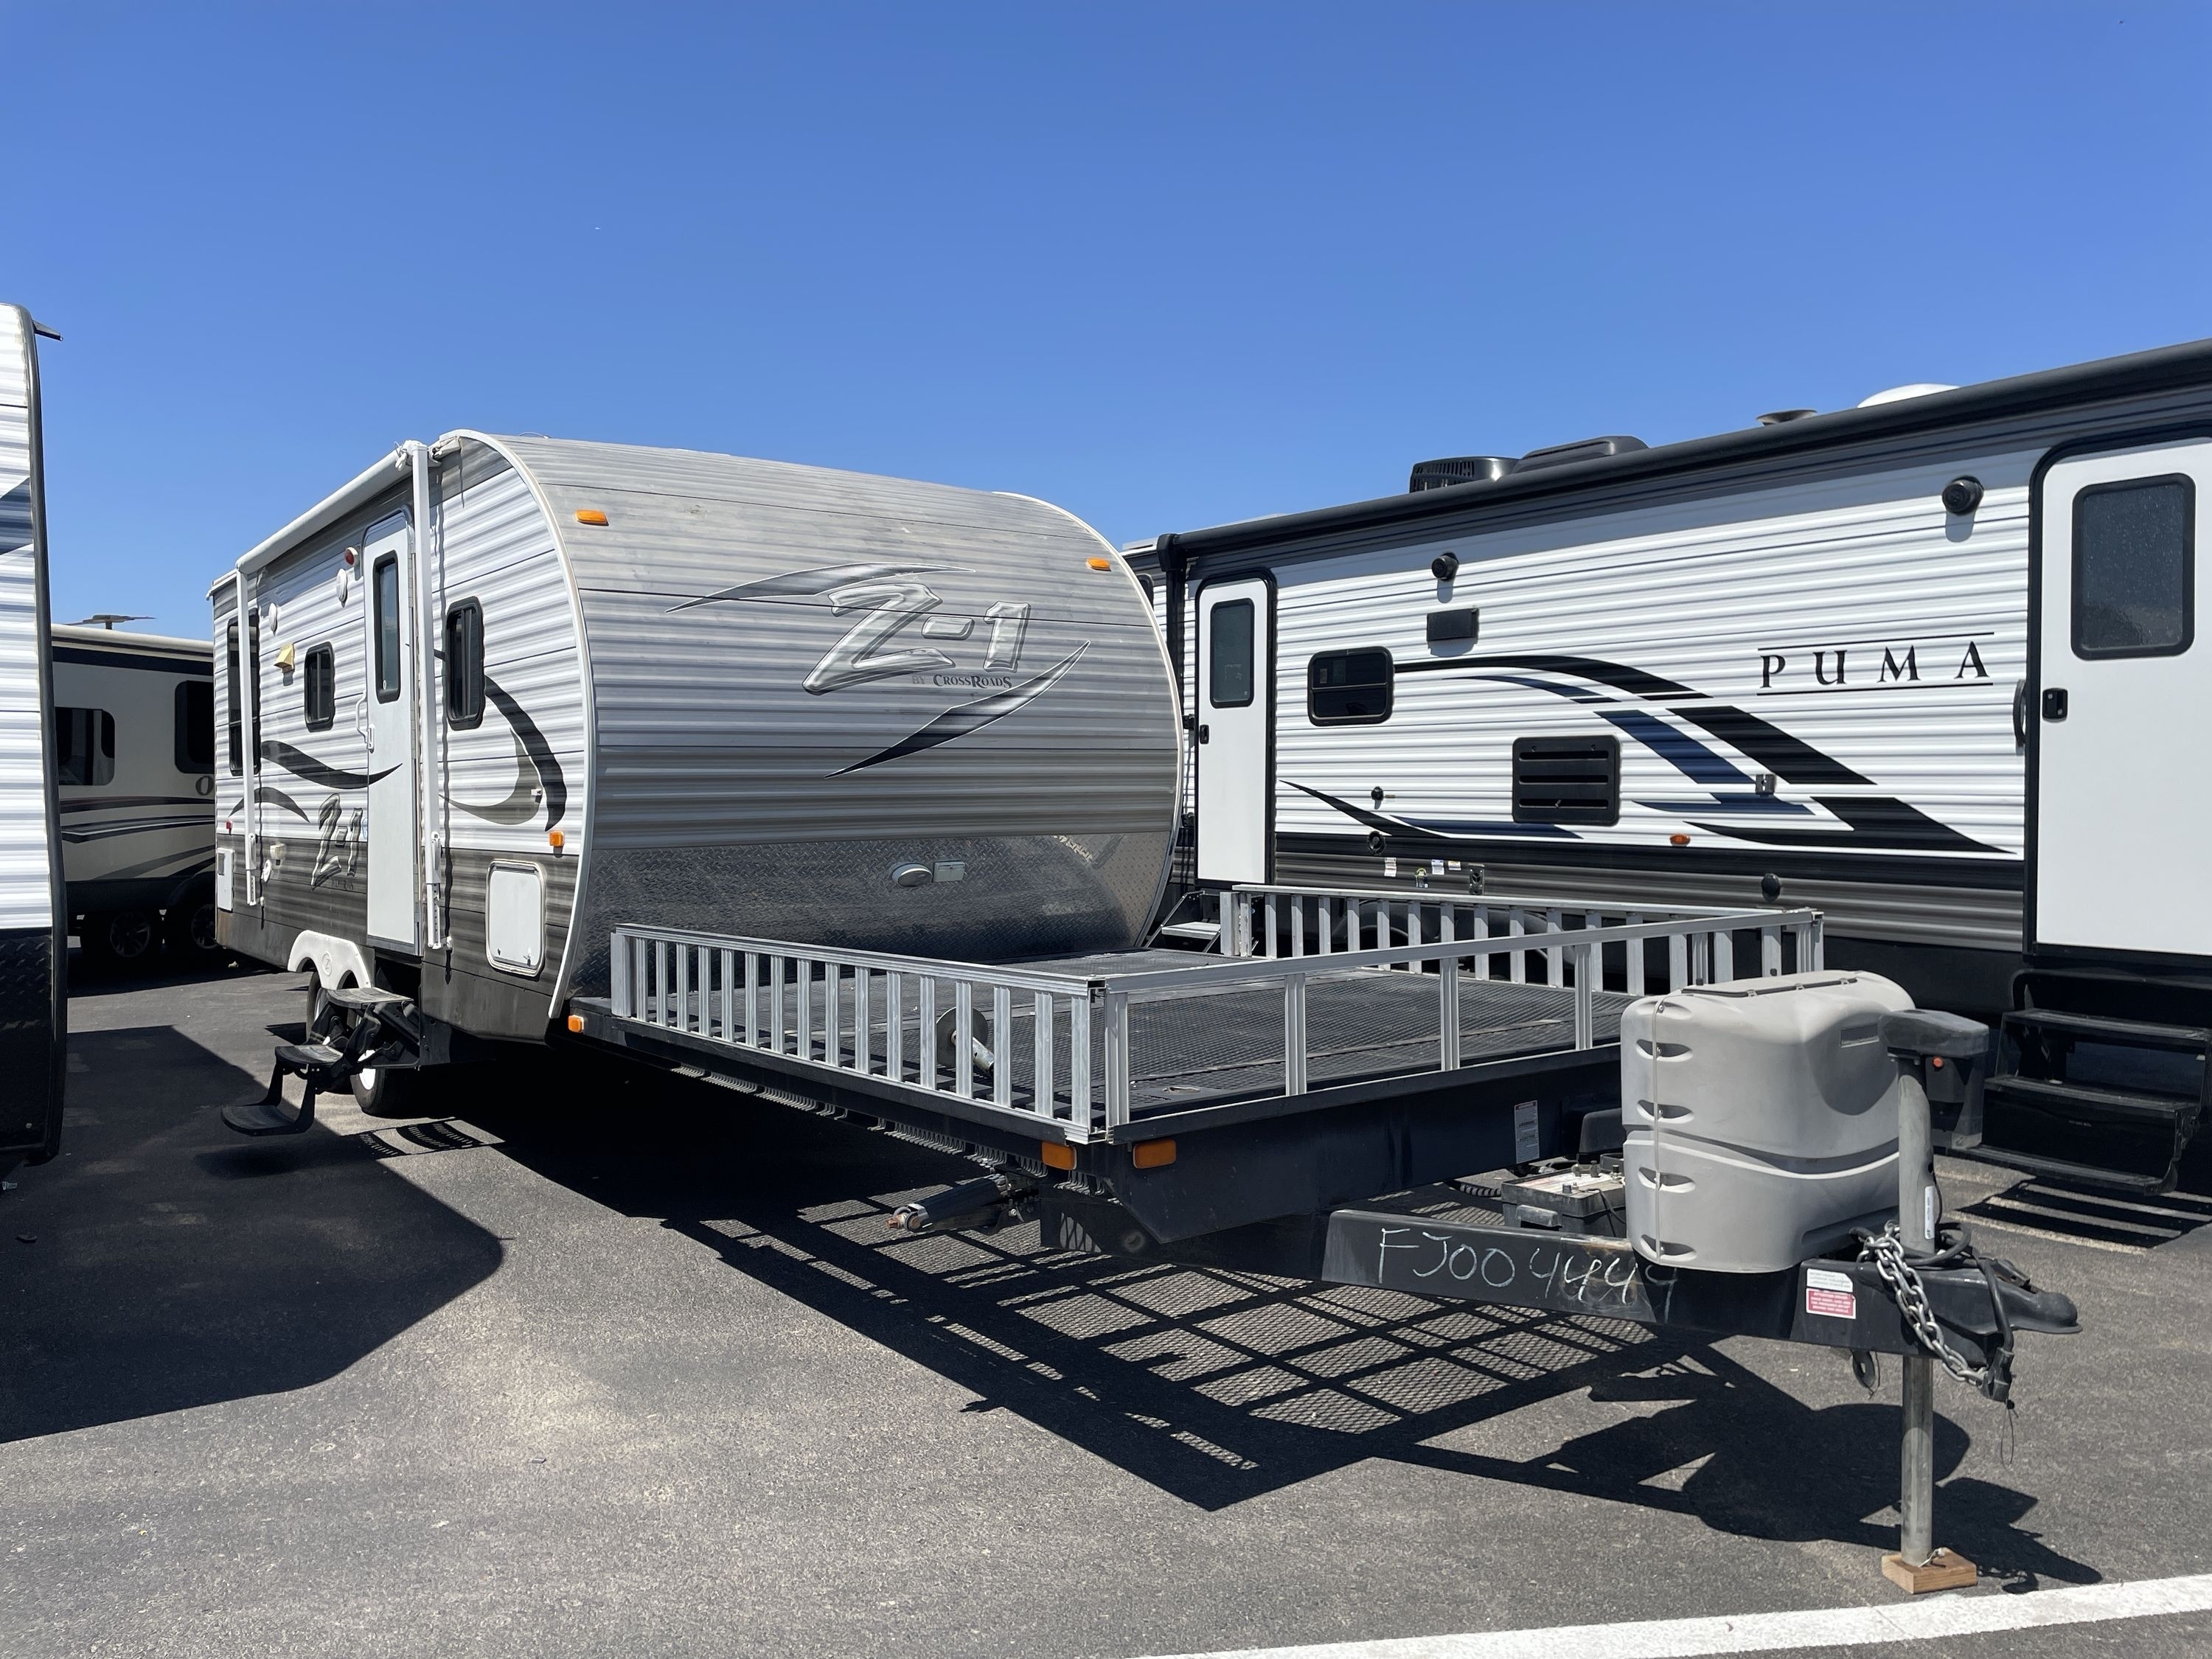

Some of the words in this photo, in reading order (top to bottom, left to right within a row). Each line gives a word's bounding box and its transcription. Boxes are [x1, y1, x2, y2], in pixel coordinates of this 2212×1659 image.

[802, 582, 1031, 696] Z-1
[912, 675, 926, 685] BY
[1759, 641, 1989, 689] PUMA
